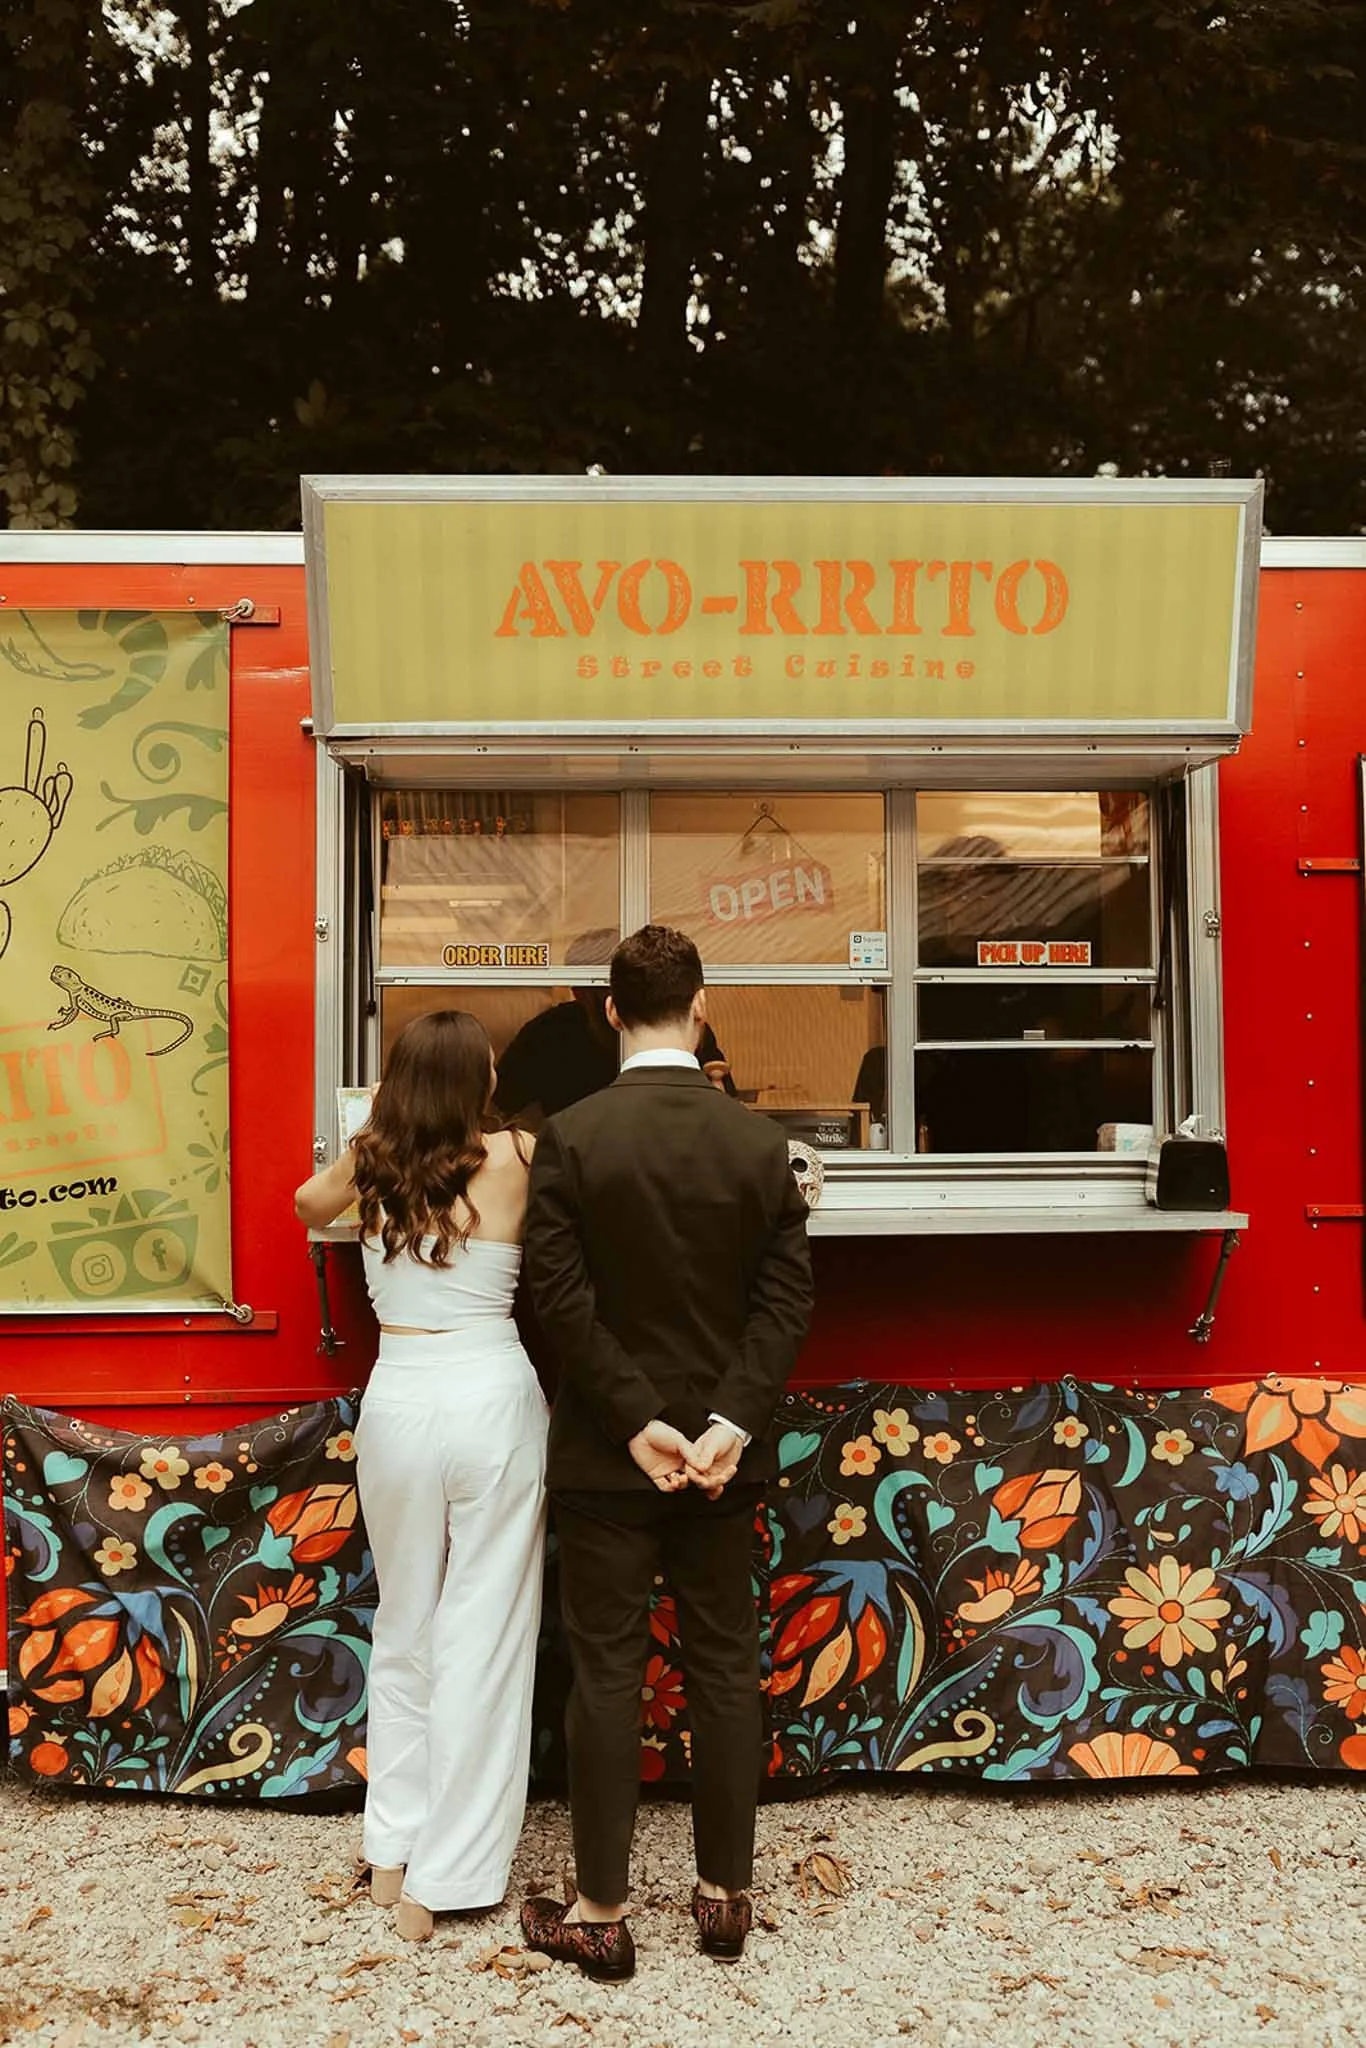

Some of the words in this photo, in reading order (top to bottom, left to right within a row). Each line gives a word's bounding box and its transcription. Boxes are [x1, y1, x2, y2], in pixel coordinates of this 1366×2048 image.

[494, 559, 1069, 637] AVO-RRITO
[576, 655, 753, 679] Street
[784, 654, 976, 680] Cuisine
[709, 866, 825, 922] OPEN
[443, 944, 502, 967] ORDER
[504, 944, 548, 967] HERE
[980, 943, 1017, 963] PICK
[1021, 943, 1045, 963] UP
[1048, 943, 1089, 963] HERE
[0, 1036, 131, 1124] ITO
